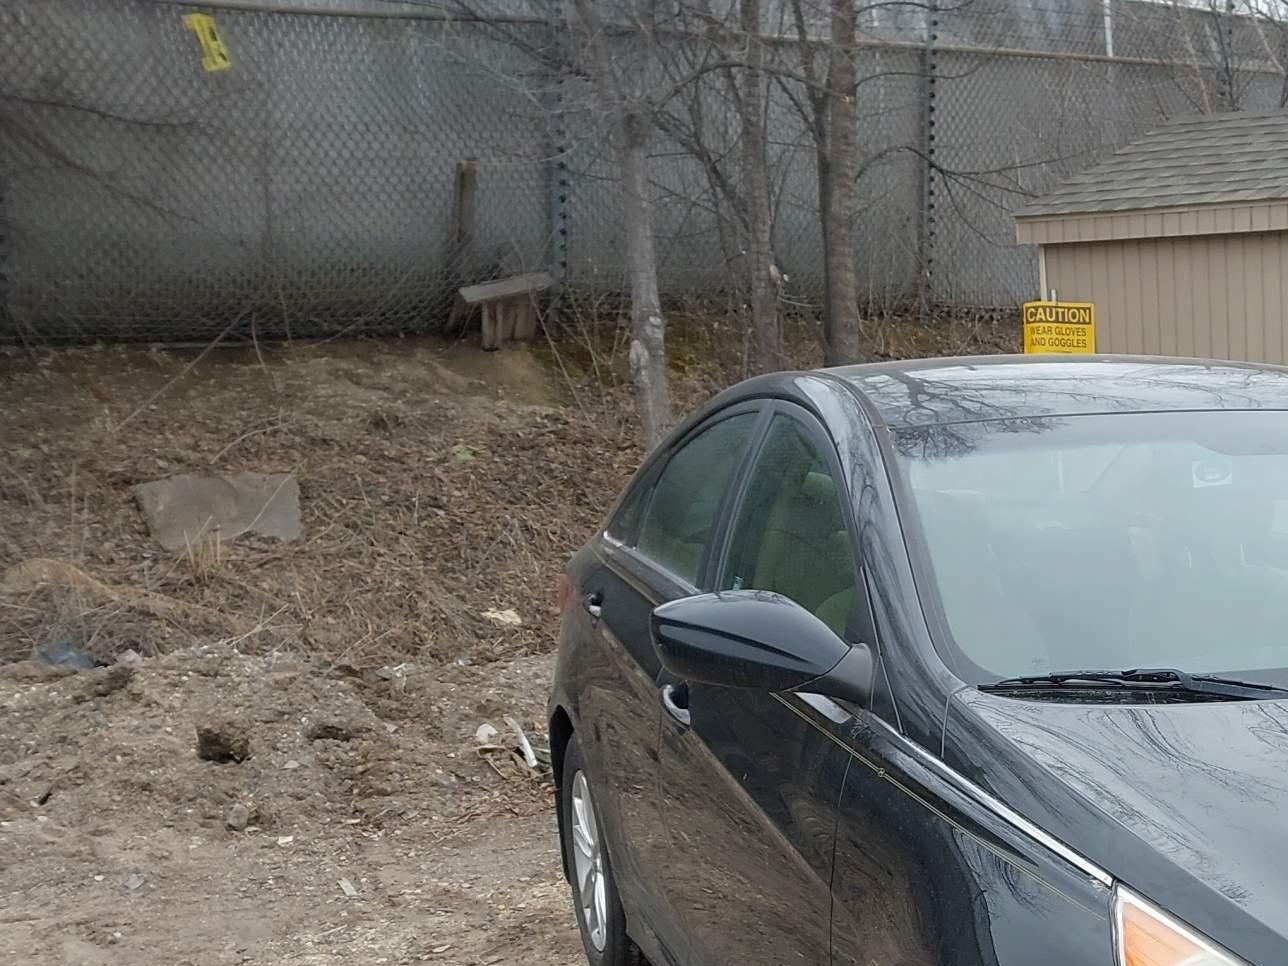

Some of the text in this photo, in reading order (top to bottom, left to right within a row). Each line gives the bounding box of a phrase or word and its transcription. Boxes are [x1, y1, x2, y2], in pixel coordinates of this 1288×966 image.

[1026, 307, 1090, 323] CAUTION
[1029, 325, 1087, 337] WEAR GLOVES
[1029, 337, 1087, 348] AND GOGGLES
